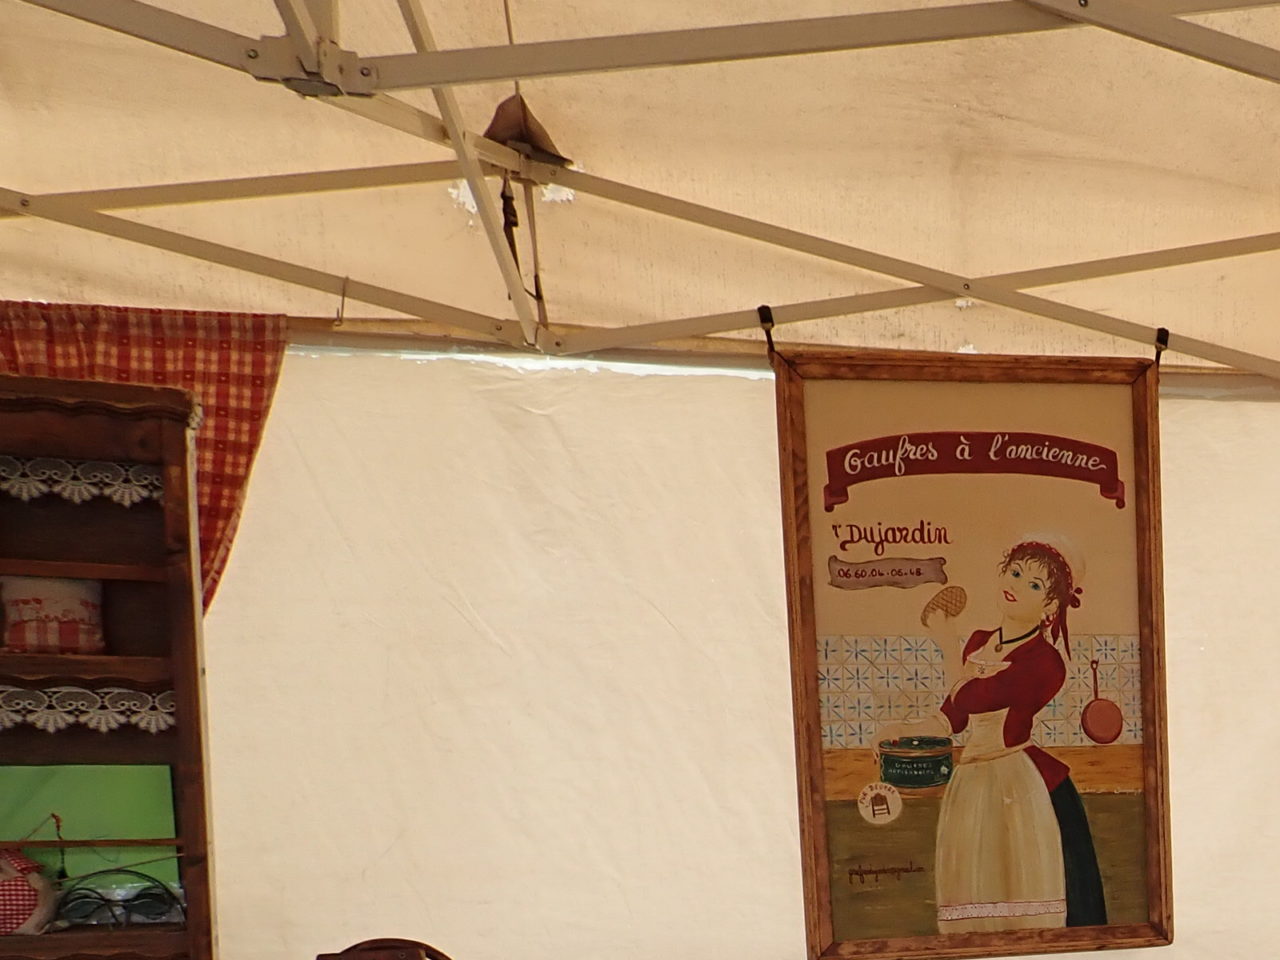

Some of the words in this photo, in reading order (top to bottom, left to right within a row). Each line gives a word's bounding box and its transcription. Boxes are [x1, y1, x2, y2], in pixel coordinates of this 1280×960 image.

[843, 435, 938, 476] Gaufres
[955, 436, 972, 460] à
[989, 434, 1107, 470] l'ancienne
[840, 519, 951, 556] Dujardin
